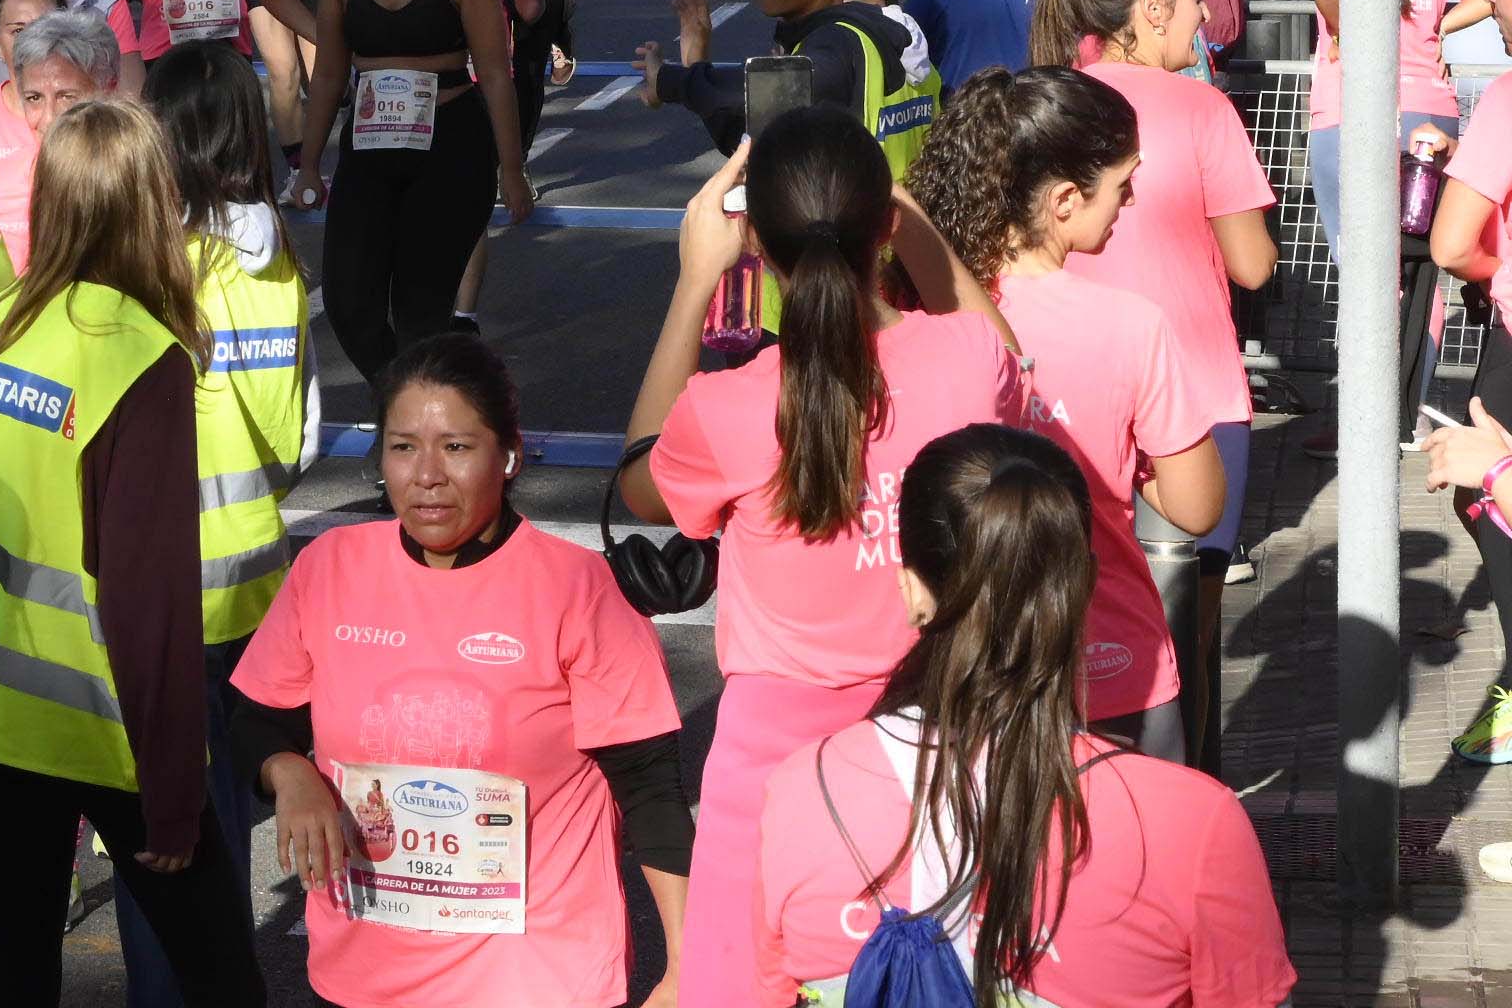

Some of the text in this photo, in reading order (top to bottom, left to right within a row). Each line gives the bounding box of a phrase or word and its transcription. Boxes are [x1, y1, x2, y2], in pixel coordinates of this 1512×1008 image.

[188, 0, 214, 11] 016
[377, 100, 406, 112] 016
[335, 624, 521, 659] OYSHO ASTURIANA
[398, 789, 511, 812] ASTURIANA SUMA
[401, 828, 461, 855] 016
[406, 859, 454, 877] 19824
[365, 876, 506, 896] CARRERA DE LA MUJER 2023
[362, 895, 509, 920] OYSHO Santander
